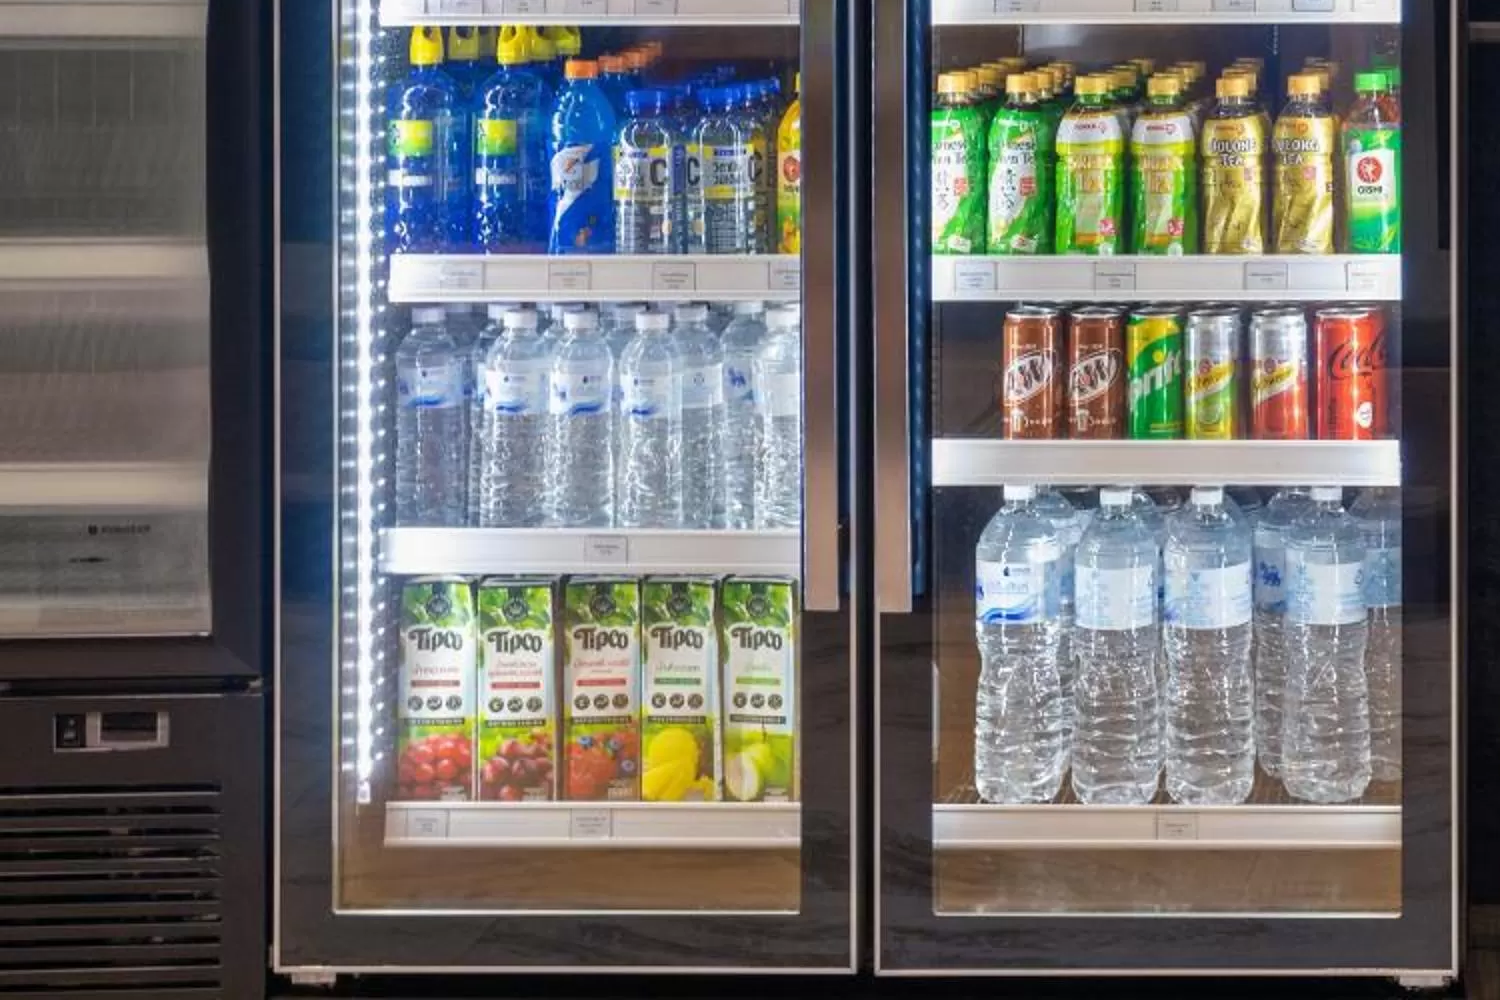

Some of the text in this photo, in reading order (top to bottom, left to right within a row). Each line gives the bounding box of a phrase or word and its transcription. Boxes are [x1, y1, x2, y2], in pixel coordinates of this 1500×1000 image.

[408, 628, 463, 652] Tipco
[487, 630, 543, 655] Tipco
[573, 627, 629, 651] Tipco
[651, 626, 704, 650] Tipco
[731, 626, 783, 650] Tipco
